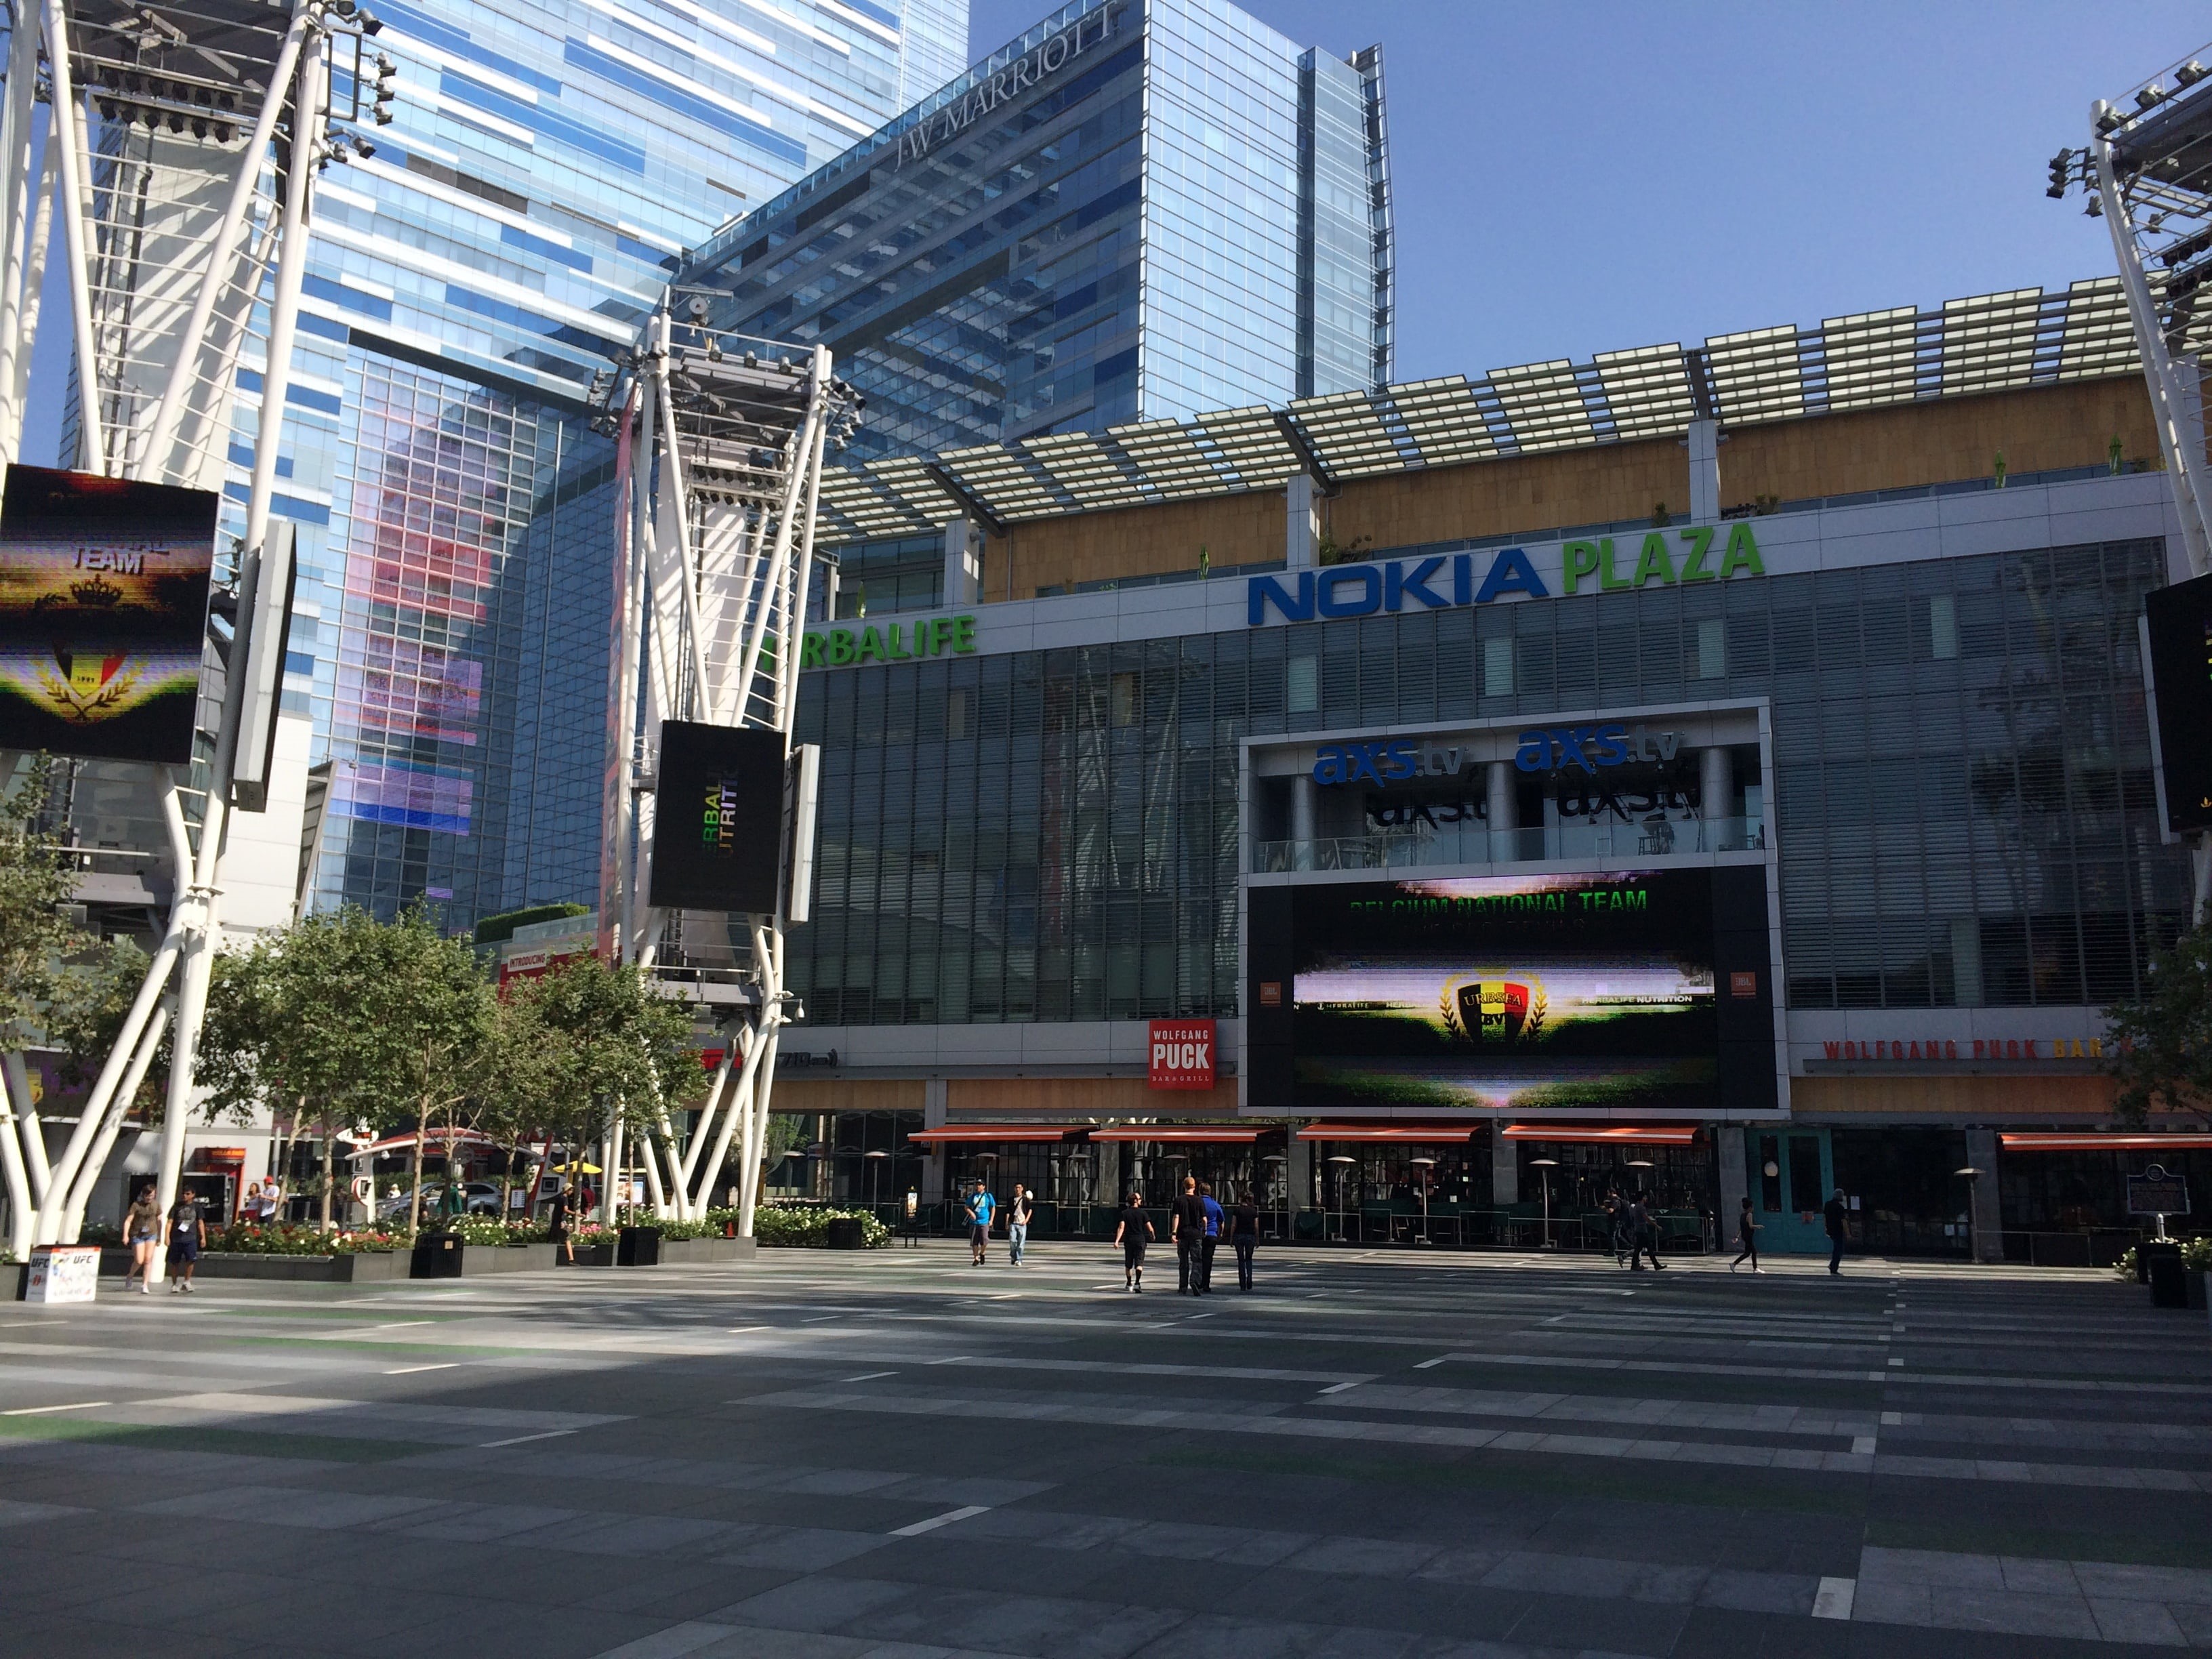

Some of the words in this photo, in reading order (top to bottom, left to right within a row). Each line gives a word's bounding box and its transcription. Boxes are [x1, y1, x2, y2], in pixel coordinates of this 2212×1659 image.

[895, 117, 935, 173] JW
[943, 0, 1118, 140] MARRIOTT
[1248, 548, 1549, 626] NOKIA
[1562, 523, 1764, 594] PLAZA
[747, 614, 977, 672] RBALIFE
[1515, 724, 1685, 775] axs.tv
[1313, 739, 1468, 788] axs.tv
[1456, 893, 1565, 916] NATIONAL
[1578, 890, 1647, 913] TEAM
[1736, 977, 1751, 986] JBL
[1463, 992, 1522, 1006] URBSFA
[1637, 995, 1692, 1004] NUTRITION
[1153, 1029, 1208, 1040] WOLFGANG
[1153, 1043, 1210, 1069] PUCK
[1823, 1040, 1957, 1060] WOLFGANG
[1973, 1039, 2038, 1060] PUCK
[2053, 1038, 2102, 1059] BAR
[31, 1257, 49, 1269] UFC
[73, 1255, 94, 1265] UFC
